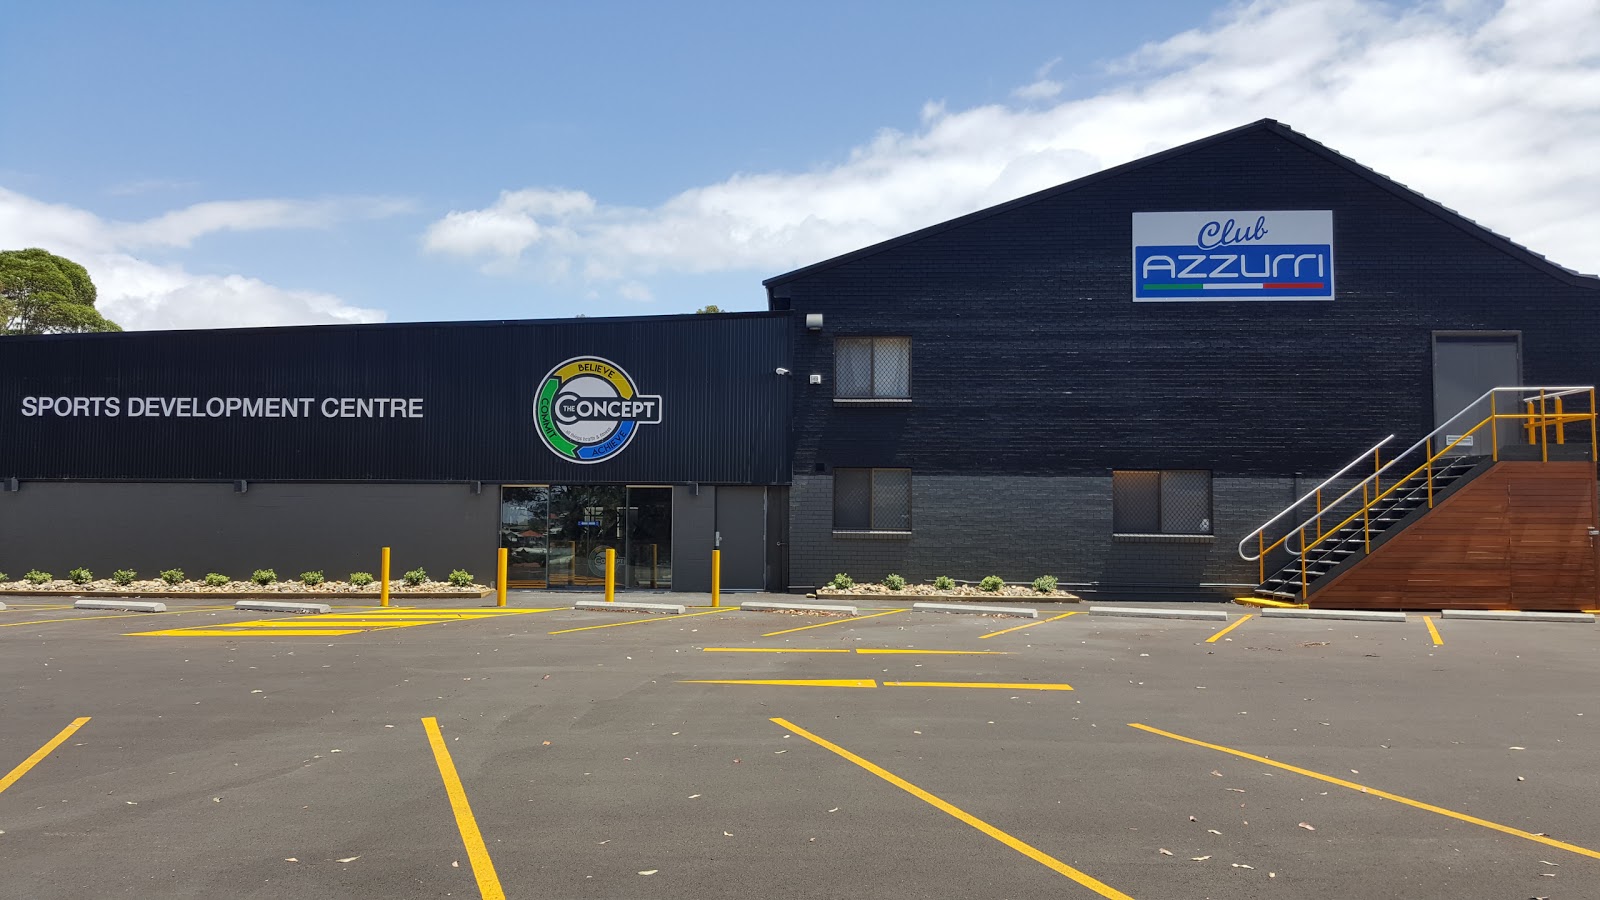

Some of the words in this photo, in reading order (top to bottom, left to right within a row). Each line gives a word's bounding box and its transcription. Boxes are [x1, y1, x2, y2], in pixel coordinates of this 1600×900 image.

[1198, 216, 1268, 249] Club
[578, 363, 615, 379] BELIEVE
[21, 396, 120, 417] SPORTS
[127, 396, 315, 418] DEVELOPMENT
[321, 397, 424, 418] CENTRE
[540, 397, 557, 438] COMMIT
[555, 394, 655, 422] CONCEPT
[592, 430, 627, 456] ACHIEVE
